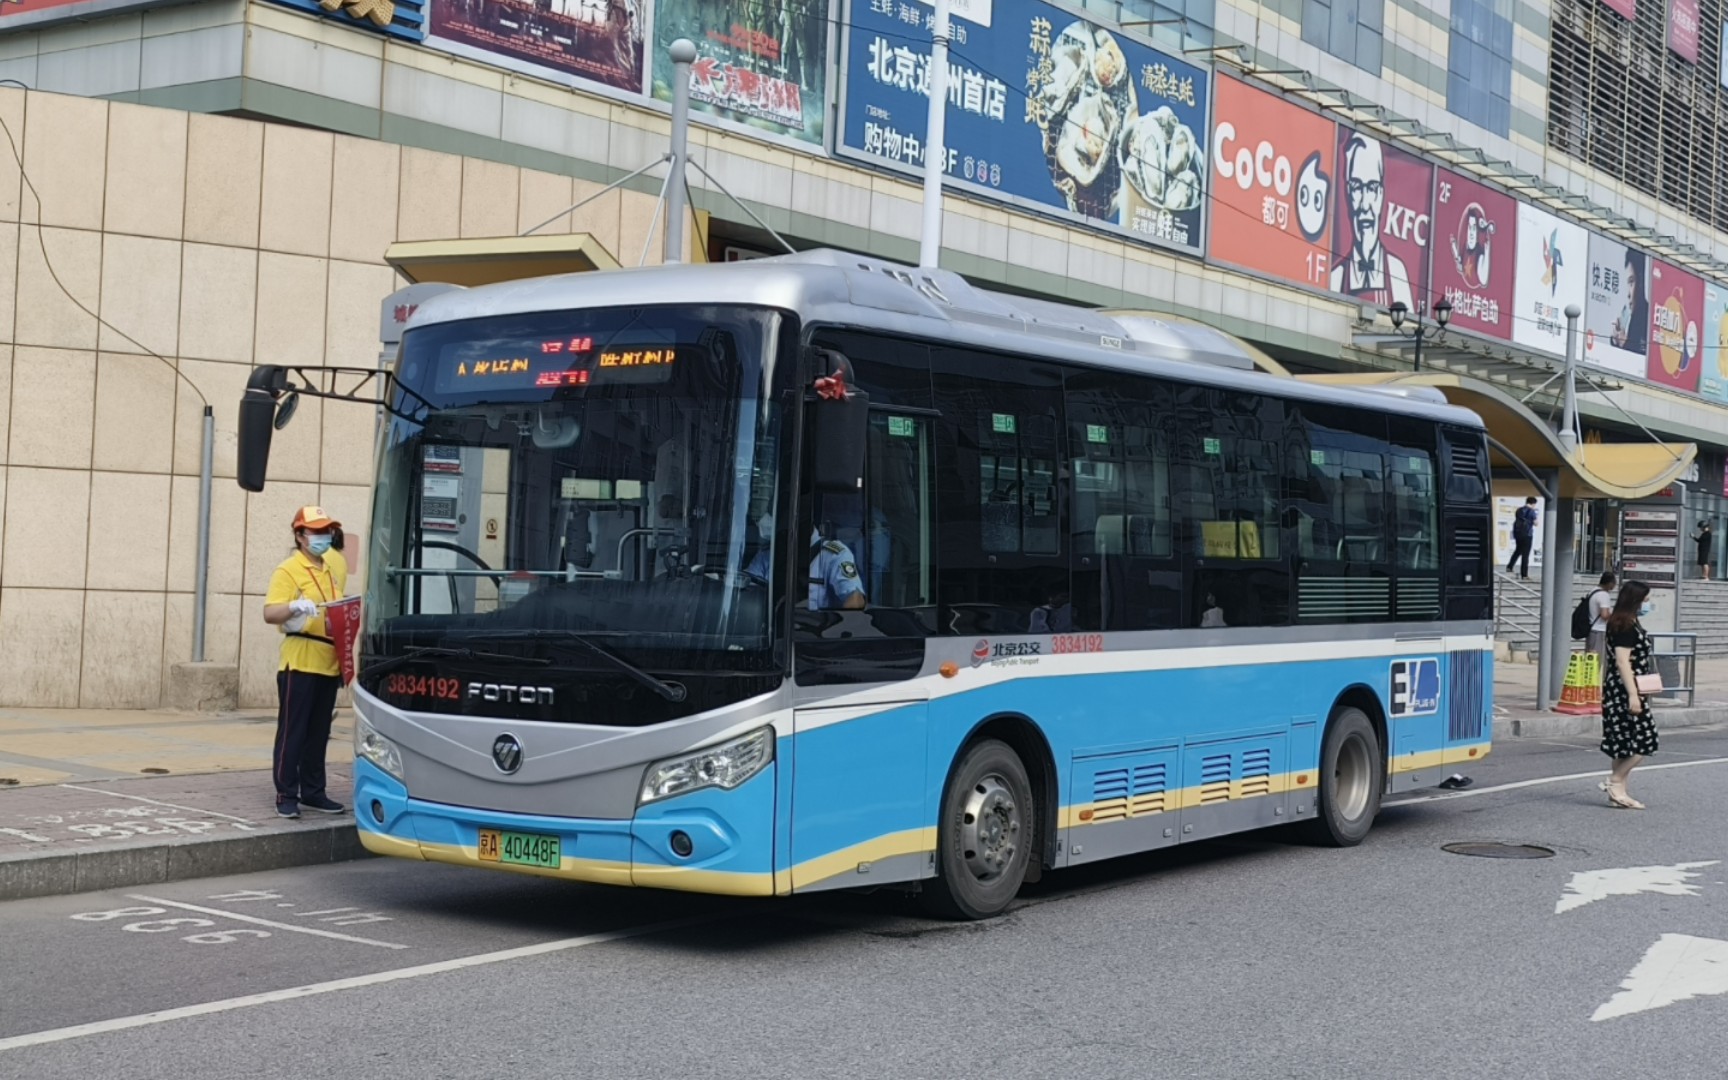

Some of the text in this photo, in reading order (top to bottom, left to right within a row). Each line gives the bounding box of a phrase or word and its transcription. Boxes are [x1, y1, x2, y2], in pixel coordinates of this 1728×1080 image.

[1214, 121, 1291, 196] CoCo
[1439, 182, 1451, 203] 2F
[1262, 195, 1289, 230] 都可
[1383, 202, 1429, 246] KFC
[1306, 250, 1326, 283] 1F
[1444, 285, 1498, 325] 比格比萨自助
[992, 642, 1041, 656] 北京公交
[1051, 634, 1103, 654] 3834192
[387, 673, 459, 699] 3834192
[468, 682, 554, 705] FOTON
[69, 906, 273, 945] 938
